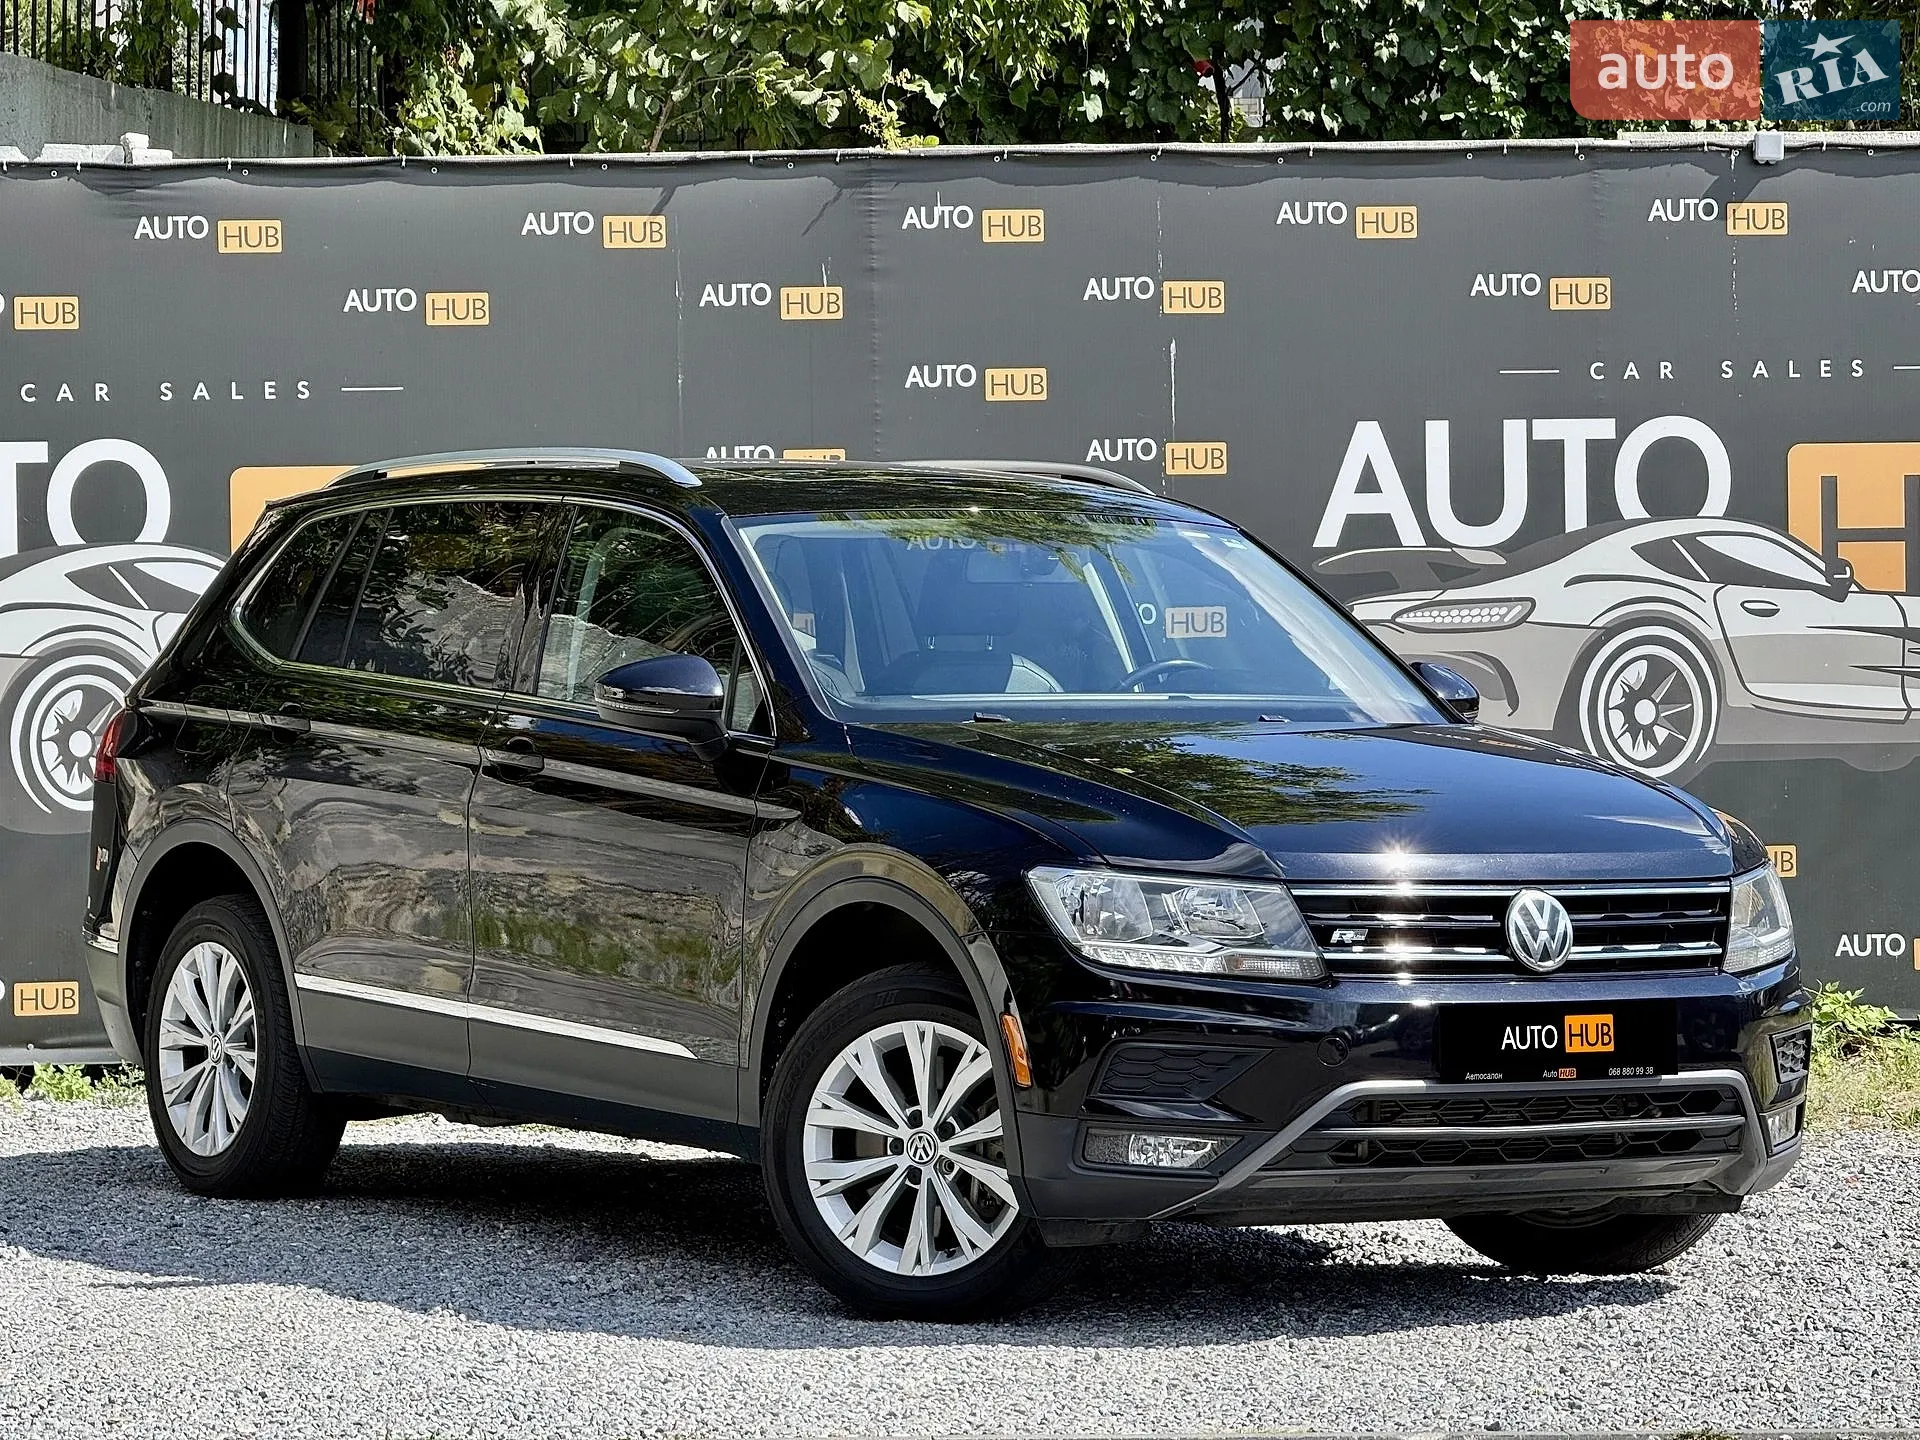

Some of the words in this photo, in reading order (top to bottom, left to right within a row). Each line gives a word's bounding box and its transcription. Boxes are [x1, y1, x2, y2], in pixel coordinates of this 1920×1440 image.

[521, 211, 594, 236] AUTO
[609, 221, 662, 244] HUB
[902, 205, 973, 230] AUTO
[988, 215, 1041, 238] HUB
[1277, 201, 1347, 225] AUTO
[1361, 213, 1414, 234] HUB
[1648, 199, 1718, 222] AUTO
[1733, 208, 1785, 231] HUB
[134, 215, 208, 240] AUTO
[224, 225, 278, 248] HUB
[1083, 277, 1154, 301] AUTO
[1168, 286, 1221, 309] HUB
[1470, 273, 1541, 297] AUTO
[1555, 283, 1608, 305] HUB
[1851, 270, 1920, 293] AUTO
[21, 302, 76, 325] HUB
[344, 287, 417, 313] AUTO
[431, 298, 486, 321] HUB
[699, 283, 772, 308] AUTO
[786, 292, 840, 315] HUB
[905, 364, 976, 389] AUTO
[990, 373, 1044, 396] HUB
[1590, 361, 1674, 380] CAR
[1722, 359, 1864, 379] SALES
[20, 382, 110, 403] CAR
[160, 380, 310, 401] SALES
[1086, 437, 1157, 462] AUTO
[1171, 447, 1225, 470] HUB
[1312, 415, 1732, 548] AUTO
[1171, 612, 1224, 634] HUB
[1835, 933, 1906, 957] AUTO
[21, 987, 76, 1011] HUB
[1501, 1025, 1558, 1050] AUTO
[1569, 1022, 1612, 1047] HUB
[1543, 1069, 1558, 1078] Auto
[1559, 1069, 1576, 1078] HUB
[1608, 1067, 1621, 1076] 068
[1645, 1066, 1654, 1075] 38
